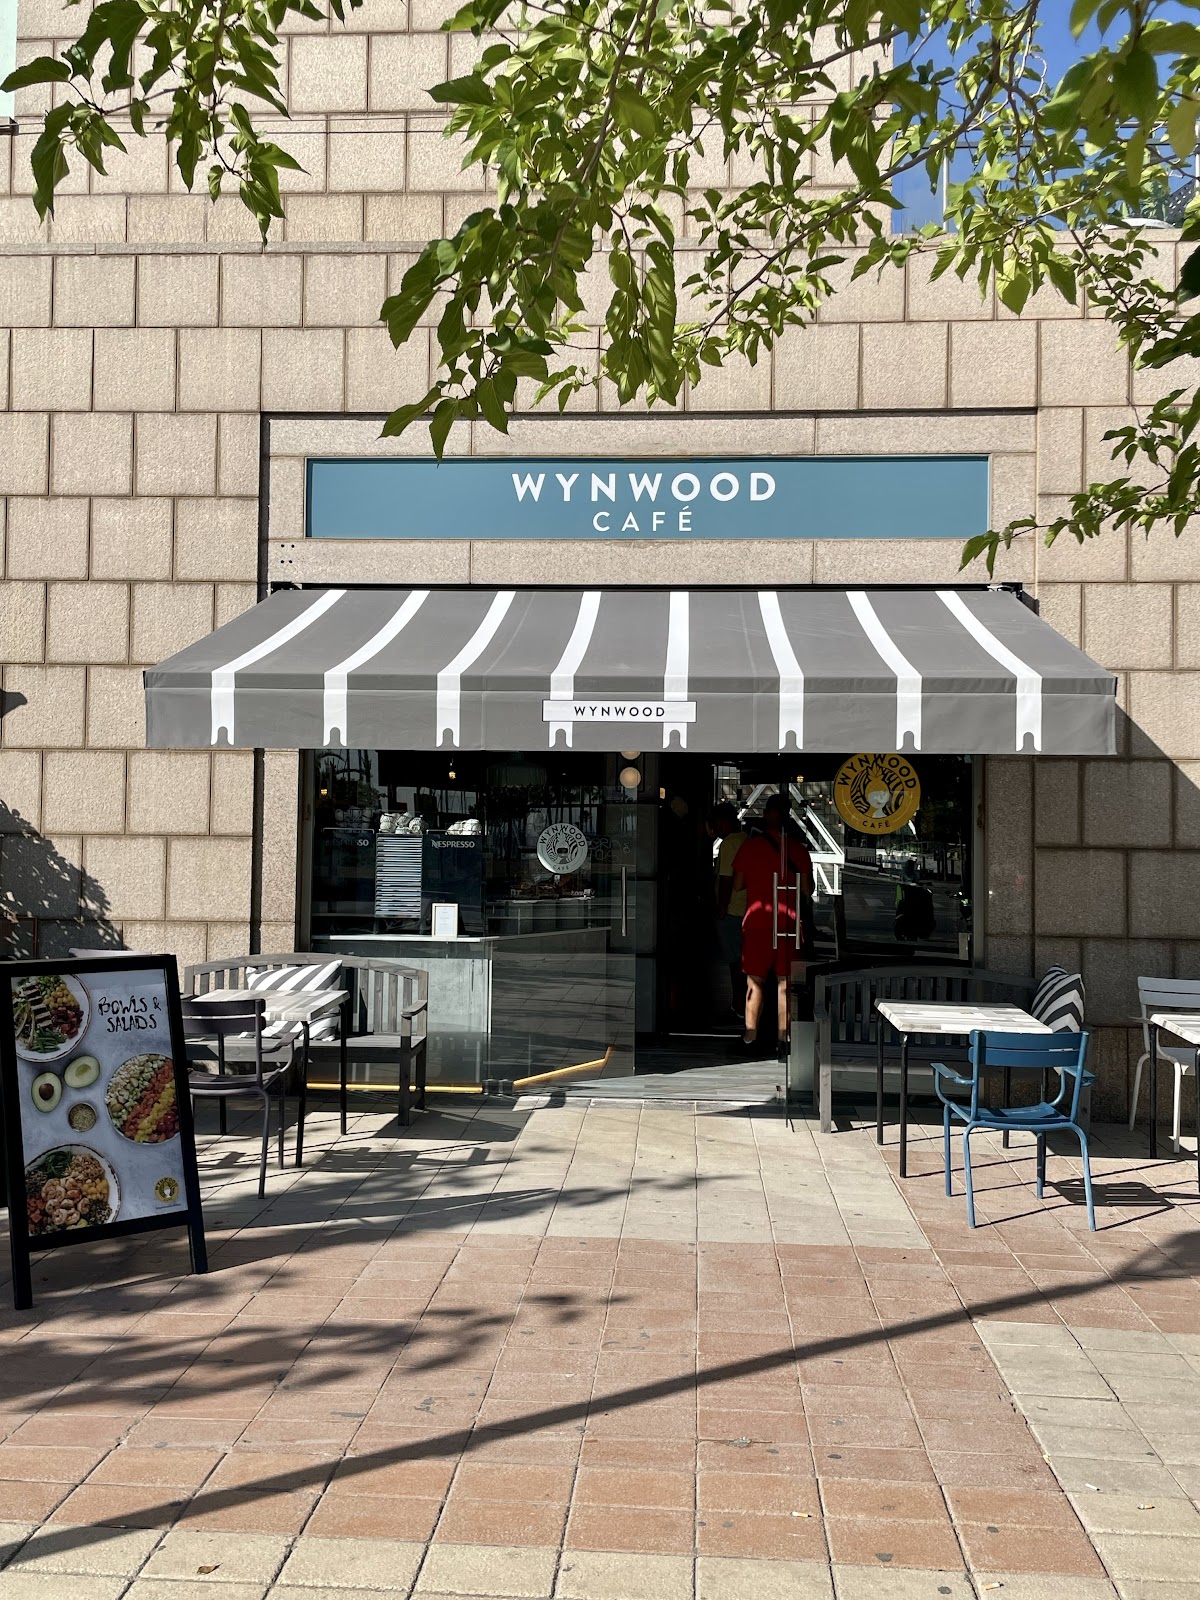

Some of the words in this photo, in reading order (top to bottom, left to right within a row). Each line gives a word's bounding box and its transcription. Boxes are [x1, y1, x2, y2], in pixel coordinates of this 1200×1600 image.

[511, 472, 776, 502] WYNWOOD
[592, 505, 692, 532] CAFÉ
[574, 706, 665, 717] WYNWOOD
[837, 753, 917, 788] WYNWOOD
[862, 820, 891, 829] CAFÉ
[431, 839, 476, 849] NESPRESSO
[539, 824, 586, 848] WYNWOOD
[98, 995, 148, 1016] BOWLS
[152, 996, 162, 1012] &
[107, 1014, 157, 1033] SALADS
